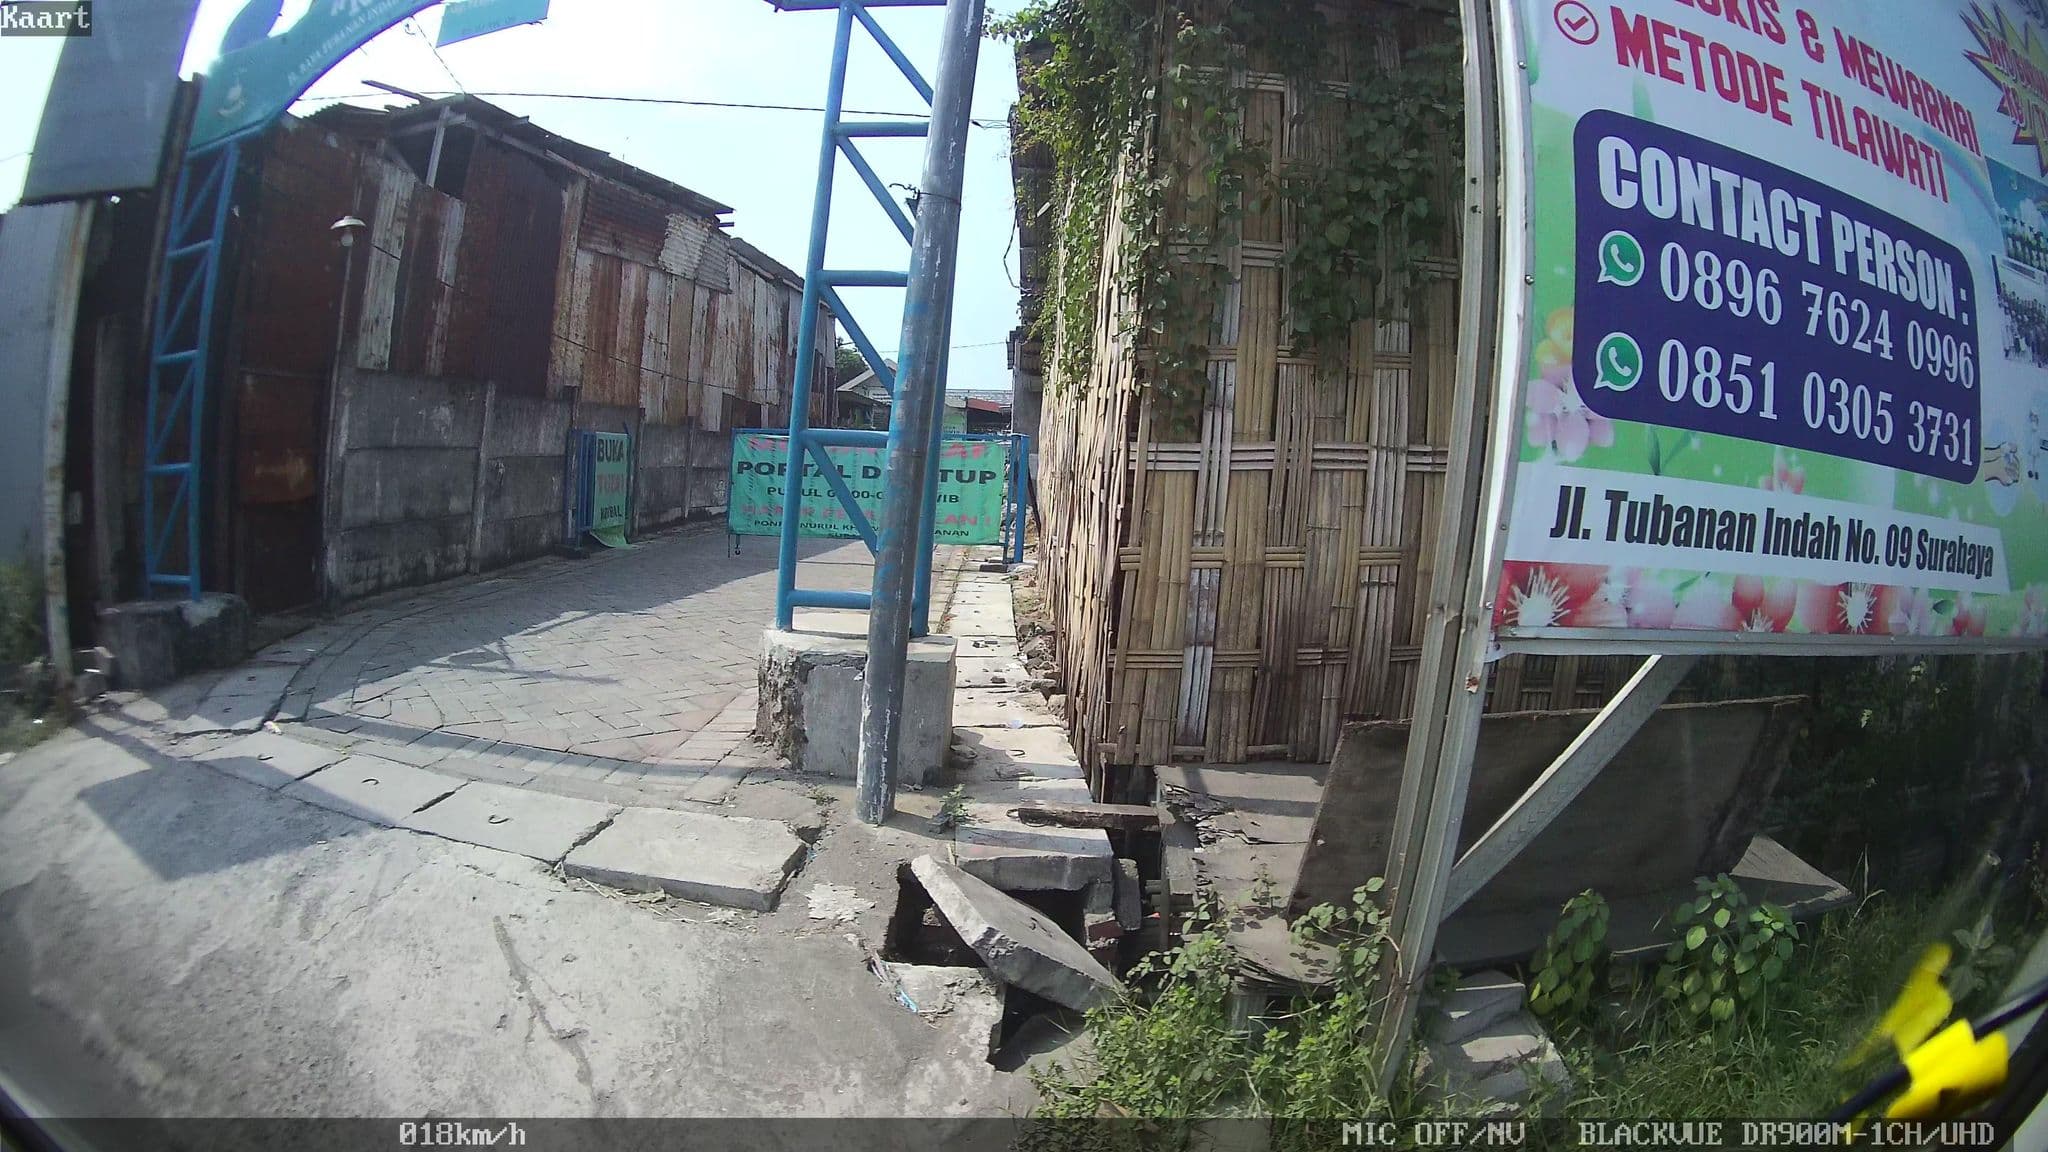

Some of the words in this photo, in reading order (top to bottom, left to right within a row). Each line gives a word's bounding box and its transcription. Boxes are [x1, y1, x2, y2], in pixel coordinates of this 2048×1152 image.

[1610, 5, 1793, 126] METODE
[1800, 79, 1949, 203] TILAWATI
[1795, 9, 1825, 63] &
[1833, 26, 1982, 157] MEWARNAI
[1598, 135, 1822, 265] CONTACT
[1830, 209, 1957, 321] PERSON
[1660, 242, 1783, 326] 0896
[1801, 280, 1894, 361] 7624
[1907, 320, 1975, 390] 0996
[597, 438, 625, 463] BUKA
[1658, 338, 1778, 420] 0851
[1803, 371, 1894, 445] 0305
[1907, 400, 1974, 466] 3731
[1549, 484, 1592, 540] Jl.
[1604, 489, 1756, 554] Tubanan
[1761, 506, 1840, 561] Indah
[1844, 517, 1880, 566] No.
[1885, 523, 1913, 569] 09
[1916, 529, 1994, 580] Surabaya
